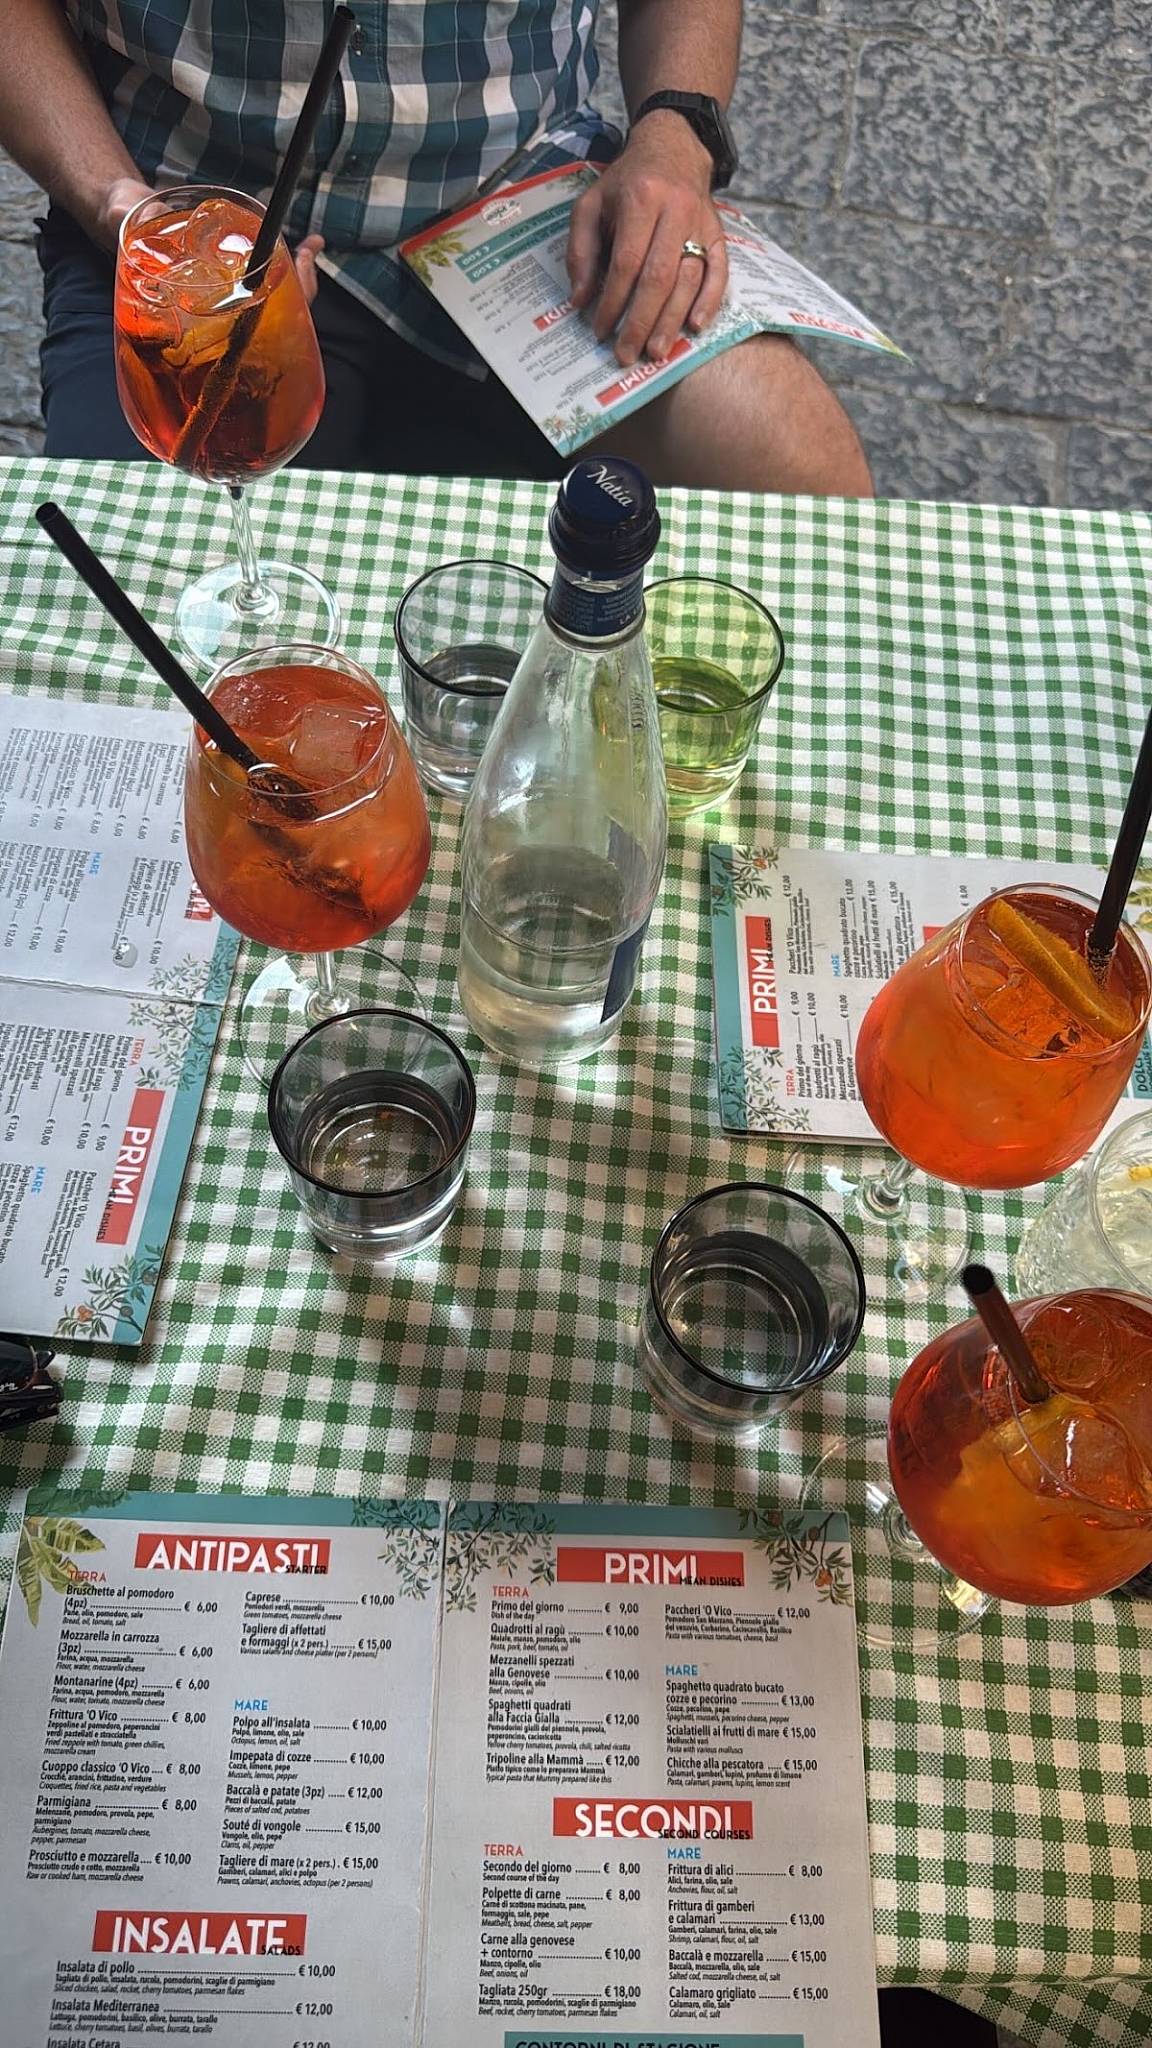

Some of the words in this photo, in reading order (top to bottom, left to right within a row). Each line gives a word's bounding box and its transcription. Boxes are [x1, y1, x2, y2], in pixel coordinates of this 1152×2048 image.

[586, 464, 634, 508] Natia
[89, 851, 102, 875] MARE
[787, 928, 795, 940] Vico
[788, 948, 796, 974] Paccheri
[831, 954, 841, 977] MARE
[750, 948, 778, 1014] PRIMI
[101, 1034, 116, 1067] Quadrotti
[120, 1036, 134, 1056] Primo
[129, 1037, 145, 1067] TERRA
[811, 1044, 822, 1060] ragù
[796, 1044, 806, 1065] giorno
[117, 1057, 128, 1069] del
[796, 1066, 805, 1077] del
[92, 1074, 103, 1091] ragù
[110, 1069, 124, 1092] giorno
[785, 1068, 795, 1096] TERRA
[798, 1076, 806, 1098] Primo
[814, 1068, 824, 1099] Quadrotti
[76, 1129, 90, 1149] 10,00
[109, 1125, 152, 1205] PRIMI
[32, 1166, 46, 1194] MARE
[82, 1171, 97, 1202] Paccheri
[78, 1203, 88, 1212] 'O
[74, 1212, 86, 1228] Vico
[96, 1212, 112, 1241] DISHES
[146, 1539, 320, 1573] ANTIPASTI
[285, 1564, 327, 1575] STARTER
[605, 1552, 698, 1584] PRIMI
[69, 1570, 107, 1582] TERRA
[710, 1577, 743, 1587] DISHES
[64, 1585, 115, 1597] Bruschette
[116, 1587, 126, 1597] al
[126, 1588, 174, 1600] pomodoro
[245, 1591, 282, 1604] Caprese
[492, 1586, 529, 1598] TERRA
[64, 1597, 87, 1610] (4pz)
[491, 1600, 518, 1614] Primo
[519, 1601, 533, 1614] del
[535, 1601, 564, 1614] giorno
[604, 1602, 610, 1613] €
[619, 1603, 639, 1615] 9,00
[665, 1604, 701, 1615] Paccheri
[702, 1605, 712, 1616] 'O
[713, 1605, 734, 1616] Vico
[60, 1630, 109, 1641] Mozzarella
[111, 1631, 120, 1642] in
[122, 1633, 159, 1643] carrozza
[242, 1624, 277, 1636] Tagliere
[278, 1624, 288, 1635] di
[290, 1625, 326, 1635] affettati
[665, 1665, 698, 1676] MARE
[53, 1674, 114, 1687] Montanarine
[114, 1677, 138, 1690] (4pz)
[175, 1679, 182, 1690] €
[188, 1680, 210, 1691] 6,00
[666, 1680, 711, 1694] Spaghetto
[712, 1681, 753, 1695] quadrato
[754, 1681, 784, 1694] bucato
[234, 1700, 268, 1711] MARE
[49, 1710, 84, 1720] Frittura
[86, 1711, 96, 1721] 'O
[98, 1711, 118, 1721] Vico
[232, 1717, 259, 1730] Polpo
[261, 1717, 310, 1728] all'insalata
[229, 1750, 274, 1764] Impepata
[275, 1751, 285, 1762] di
[286, 1753, 312, 1762] cozze
[349, 1753, 356, 1764] €
[359, 1753, 384, 1765] 10,00
[666, 1758, 701, 1772] Chicche
[703, 1758, 719, 1769] alla
[720, 1759, 764, 1772] pescatora
[783, 1760, 790, 1770] €
[792, 1760, 817, 1772] 15,00
[36, 1796, 91, 1809] Parmigiana
[222, 1819, 250, 1830] Souté
[251, 1820, 261, 1831] di
[263, 1820, 301, 1834] vongole
[574, 1803, 733, 1839] SECONDI
[658, 1829, 699, 1839] SECOND
[704, 1829, 751, 1840] COURSES
[483, 1843, 524, 1857] TERRA
[667, 1848, 701, 1859] MARE
[28, 1850, 78, 1862] Prosciutto
[79, 1852, 86, 1861] e
[87, 1852, 139, 1863] mozzarella
[154, 1854, 161, 1864] €
[164, 1854, 191, 1866] 10,00
[483, 1861, 522, 1872] Secondo
[524, 1861, 539, 1873] del
[541, 1862, 572, 1875] giorno
[668, 1864, 702, 1875] Frittura
[703, 1864, 713, 1875] di
[715, 1864, 734, 1876] alici
[482, 1873, 506, 1881] Second
[506, 1874, 527, 1882] course
[528, 1874, 535, 1882] of
[536, 1874, 547, 1882] the
[547, 1874, 560, 1884] day
[668, 1900, 702, 1911] Frittura
[704, 1900, 714, 1912] di
[716, 1900, 755, 1914] gamberi
[112, 1917, 287, 1955] INSALATE
[480, 1933, 508, 1945] Carne
[510, 1934, 528, 1945] alla
[529, 1936, 575, 1948] genovese
[260, 1945, 302, 1956] SALADS
[668, 1949, 703, 1961] Baccalà
[705, 1952, 711, 1961] e
[713, 1950, 764, 1961] mozzarella
[56, 1961, 96, 1973] Insalata
[97, 1962, 108, 1973] di
[109, 1963, 135, 1977] pollo
[478, 1984, 516, 1998] Tagliata
[517, 1984, 548, 1999] 250gr
[604, 1986, 611, 1998] €
[613, 1986, 641, 1999] 18,00
[669, 1987, 714, 1999] Calamaro
[716, 1988, 756, 2002] grigliato
[51, 2000, 91, 2012] Insalata
[92, 2000, 160, 2013] Mediterranea
